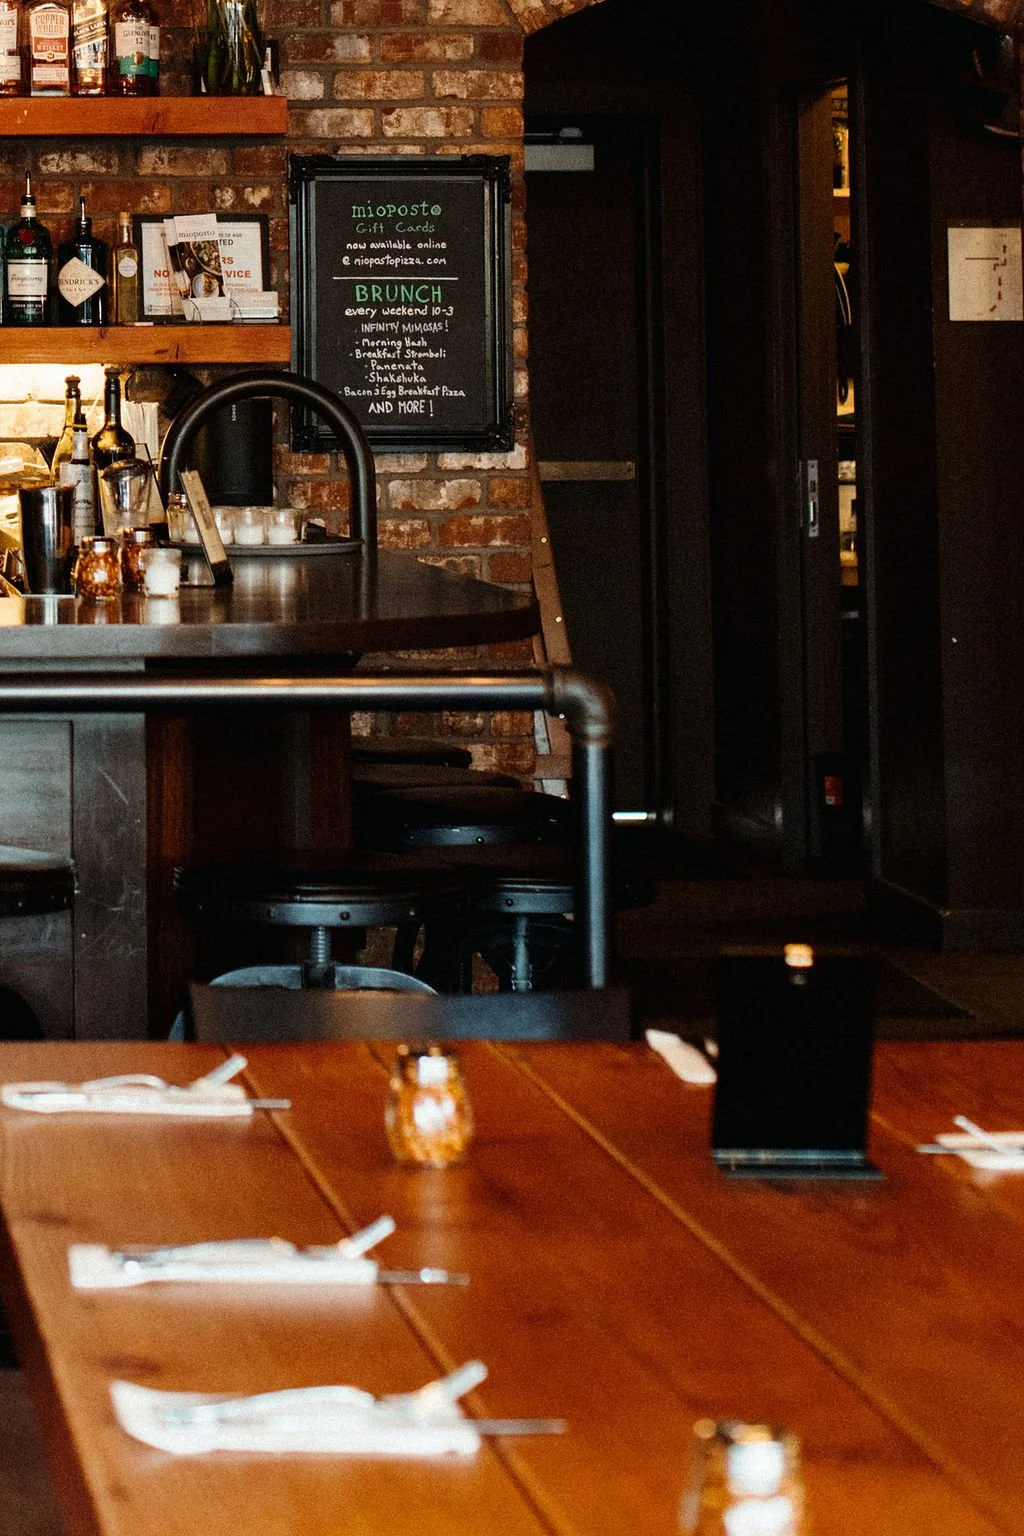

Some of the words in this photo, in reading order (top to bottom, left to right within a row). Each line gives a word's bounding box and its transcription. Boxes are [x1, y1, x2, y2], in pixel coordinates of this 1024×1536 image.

[356, 222, 384, 233] Gift
[395, 220, 436, 233] Cards
[369, 239, 412, 250] available
[417, 238, 447, 249] online
[154, 270, 170, 278] NO
[225, 270, 251, 278] VICE
[355, 284, 442, 303] BRUNCH
[344, 307, 377, 319] every
[382, 305, 428, 316] weekend
[432, 306, 454, 316] 10-3
[361, 321, 399, 333] INFINITY
[362, 337, 403, 349] Morning
[404, 336, 428, 347] Hash
[355, 348, 401, 359] Breakfast
[404, 348, 446, 358] Stromboli
[369, 372, 427, 383] Shakshuka
[344, 386, 373, 396] Bacon
[381, 386, 397, 398] Egg
[398, 385, 441, 396] Breakfast
[442, 386, 466, 397] Pizza
[368, 402, 394, 414] AND
